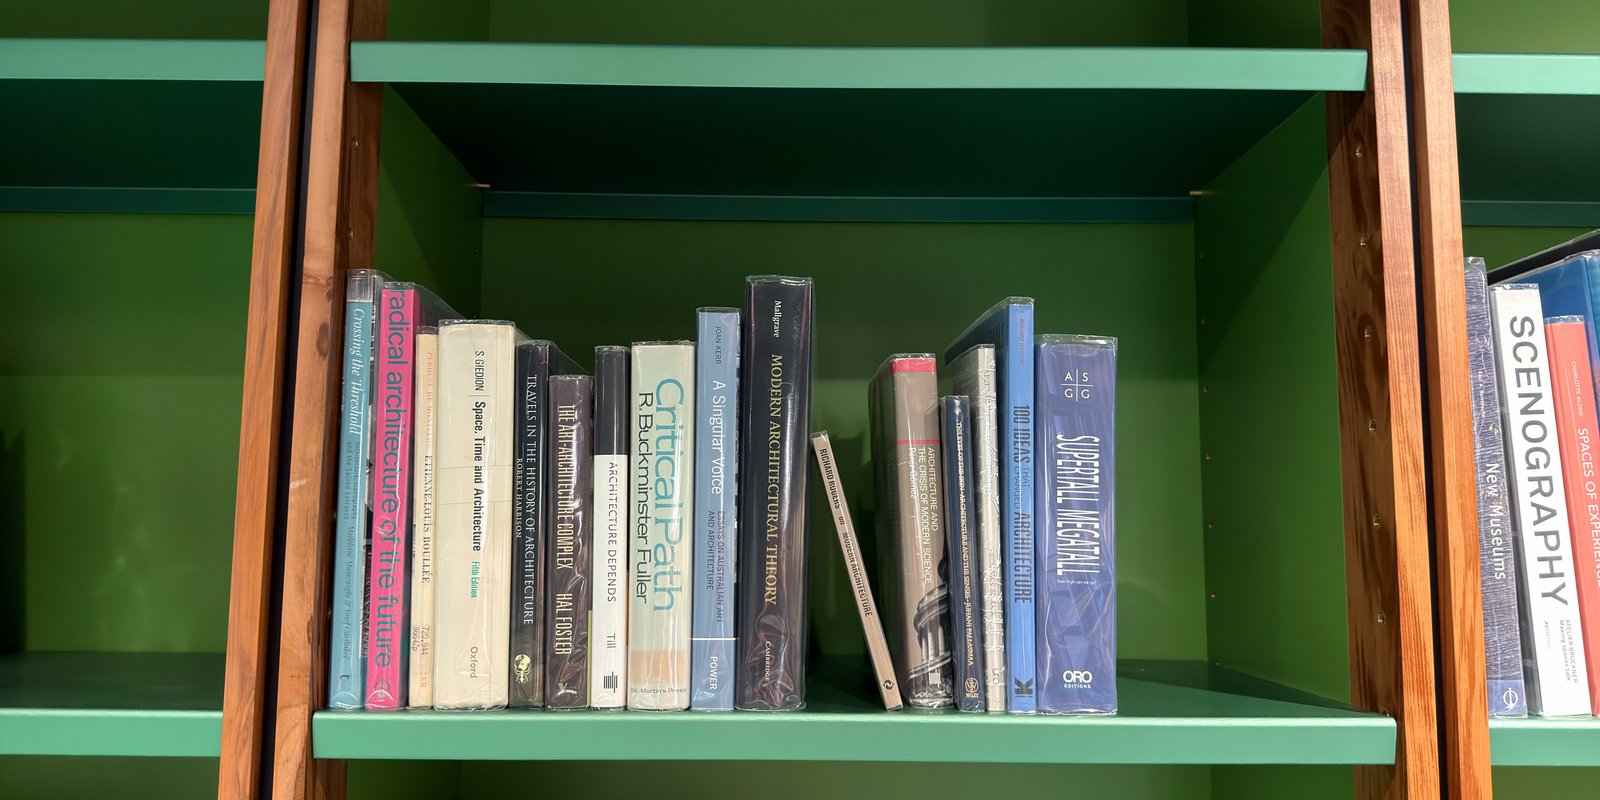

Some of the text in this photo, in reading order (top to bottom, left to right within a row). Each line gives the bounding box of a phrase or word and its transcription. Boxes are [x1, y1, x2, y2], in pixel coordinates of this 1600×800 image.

[772, 300, 782, 338] Mallgrave
[348, 308, 365, 435] Crossing the Threshold
[474, 350, 484, 391] S. GIEDION
[1064, 372, 1088, 382] A S
[1064, 388, 1090, 399] G G
[1571, 360, 1584, 417] CHARLOTTE KLONK
[709, 380, 726, 495] A Singular Voice
[1013, 404, 1031, 464] 100 IDEAS
[1509, 315, 1569, 606] SCENOGRAPHY
[1578, 428, 1595, 477] SPACES
[375, 287, 410, 668] radical architecture of the future
[470, 401, 486, 598] Space, Time and Architecture Fifth Edition
[523, 374, 538, 624] TRAVELS IN THE HISTORY OF ARCHITECTURE
[556, 404, 577, 570] THE ART-ARCHITECTURE COMPLEX
[636, 392, 653, 604] R. Buckminster Fuller
[653, 378, 685, 612] Critical Path
[762, 354, 783, 606] MODERN ARCHITECTURAL THEORY
[927, 447, 939, 532] ARCHITECTURE AND
[1013, 464, 1021, 510] CHANGED
[1022, 466, 1030, 489] THAT
[1056, 434, 1100, 576] SUPERTALL MEGATALL
[1585, 481, 1597, 500] OF
[346, 526, 354, 559] Madeleine
[607, 462, 618, 602] ARCHITECTURE DEPENDS
[819, 448, 873, 617] RICHARD ROGERS on MODERN ARCHITECTURE
[918, 446, 932, 584] THE CRISIS OF MODERN SCIENCE
[959, 494, 969, 546] ARCHITECTURE
[1485, 463, 1506, 580] New Museums
[421, 536, 433, 584] BOULLÉE
[706, 511, 715, 591] AND ARCHITECTURE
[715, 511, 725, 623] ESSAYS ON AUSTRALIAN ART
[1013, 511, 1033, 603] ARCHITECTURE
[342, 608, 352, 626] Yosef
[963, 575, 971, 600] SENSES
[341, 627, 352, 659] Garfinkel
[420, 626, 430, 655] 720.944
[555, 593, 573, 655] HAL FOSTER
[607, 633, 616, 649] Till
[1559, 619, 1567, 643] Making
[1565, 619, 1579, 684] ATELIER BRÜCKNER
[470, 646, 479, 678] Oxford
[709, 656, 718, 690] POWER
[1062, 670, 1093, 683] ORO
